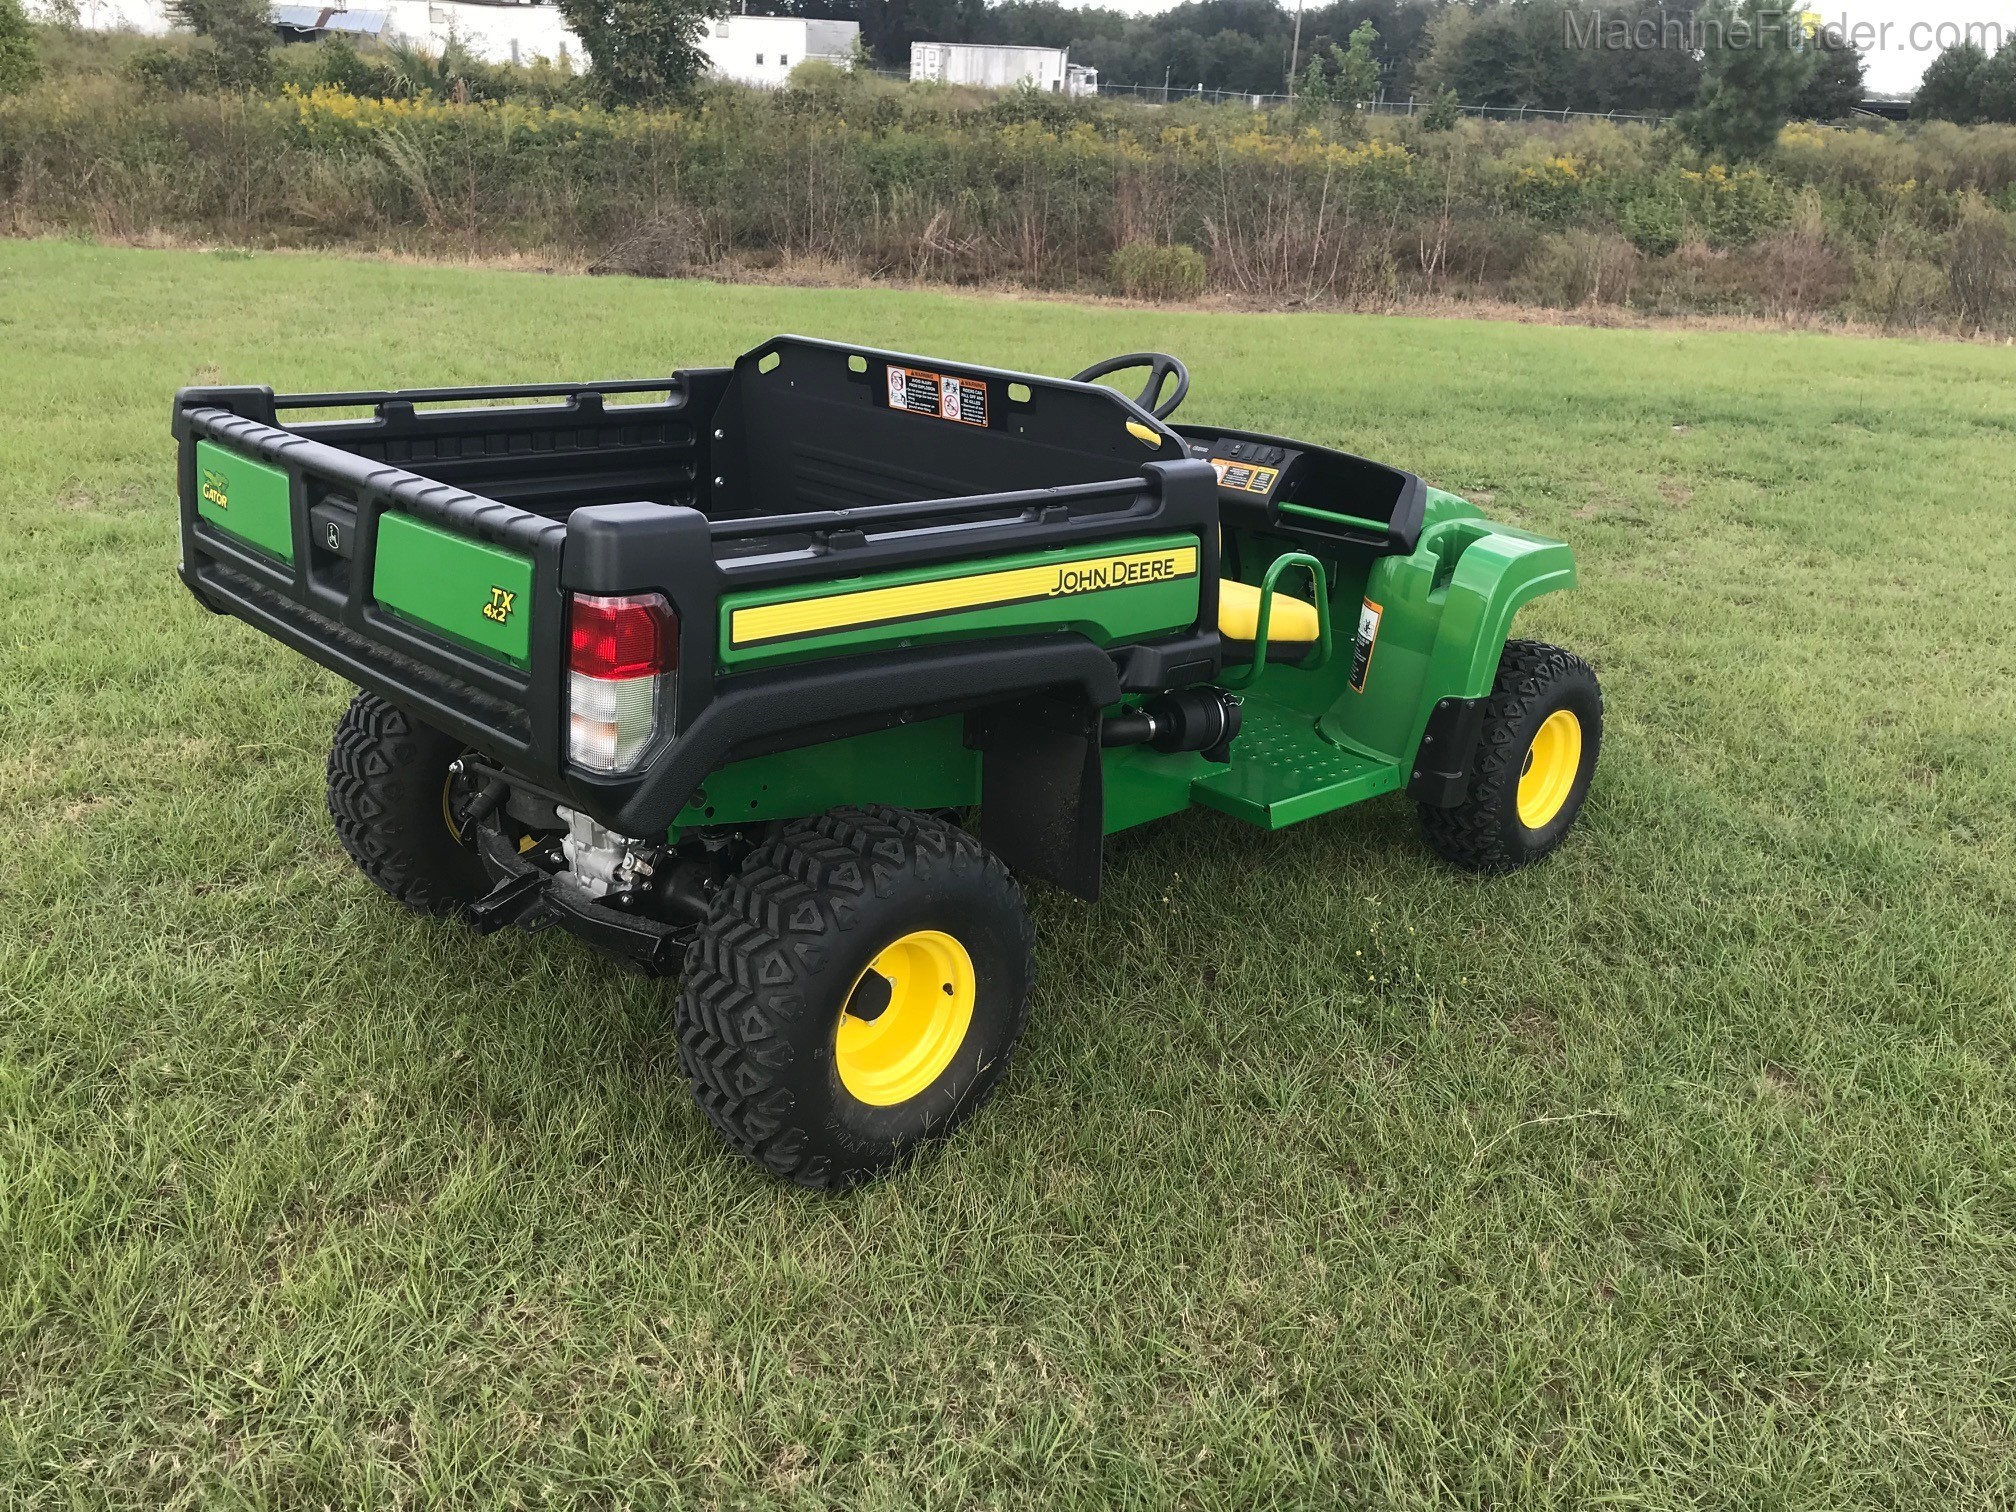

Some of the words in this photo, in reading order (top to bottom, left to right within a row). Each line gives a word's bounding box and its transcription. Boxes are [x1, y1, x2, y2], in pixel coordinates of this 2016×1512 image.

[202, 482, 228, 508] GATOR
[1051, 567, 1107, 593] JOHN
[1112, 558, 1175, 584] DEERE
[492, 587, 514, 612] TX
[483, 603, 506, 622] 4x2
